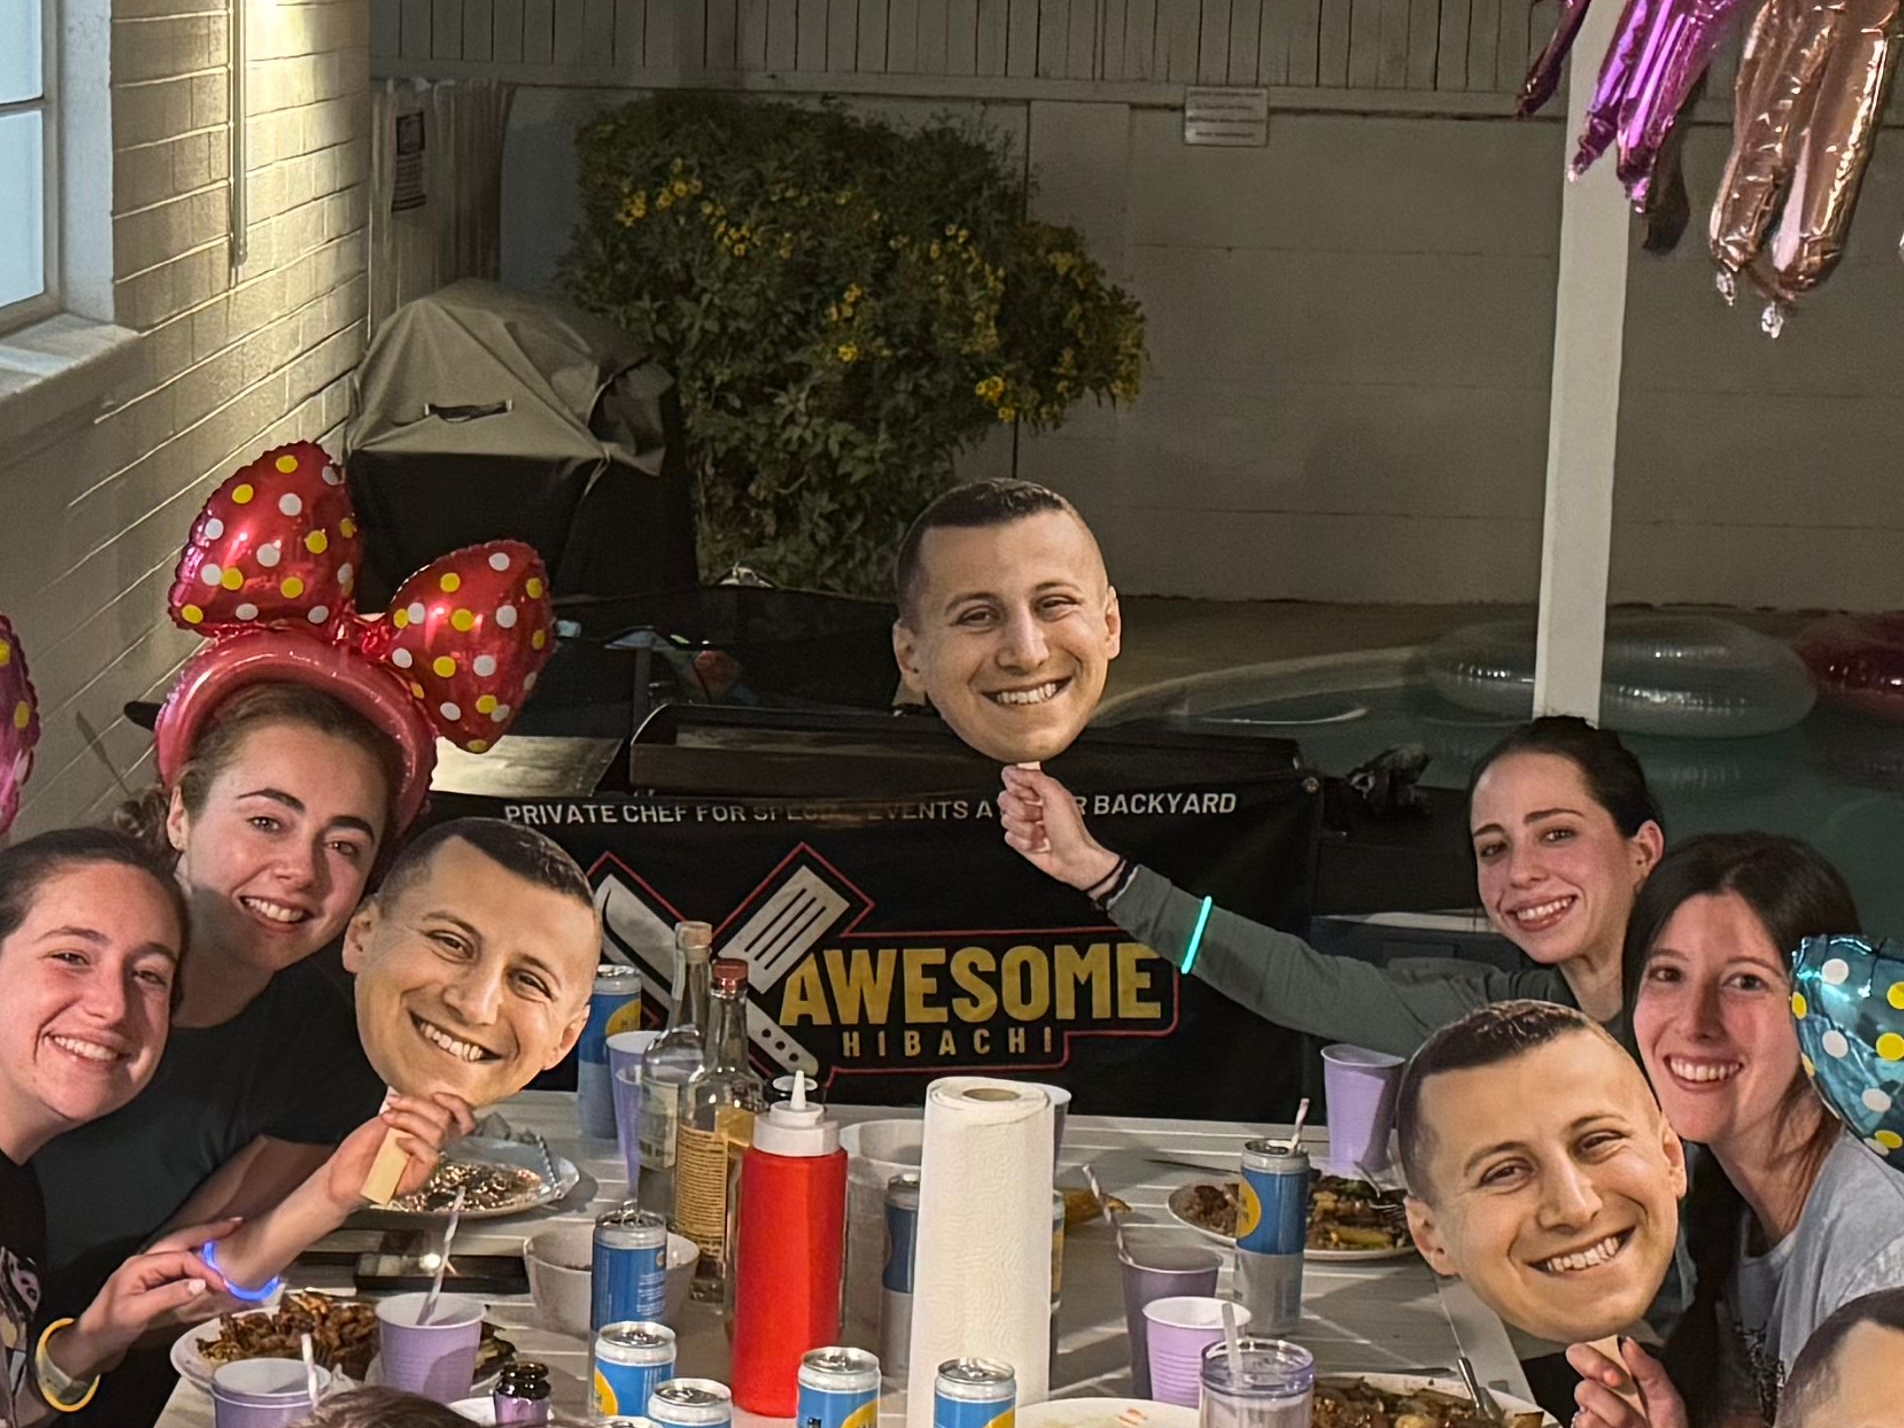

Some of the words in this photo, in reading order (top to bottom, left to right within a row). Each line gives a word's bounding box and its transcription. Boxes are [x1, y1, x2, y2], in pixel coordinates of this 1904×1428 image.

[504, 804, 618, 824] PRIVATE
[623, 804, 688, 823] CHEF
[696, 804, 746, 822] FOR
[1093, 792, 1237, 816] BACKYARD
[779, 942, 1162, 1027] AWESOME
[842, 1026, 1053, 1057] HIBACHI
